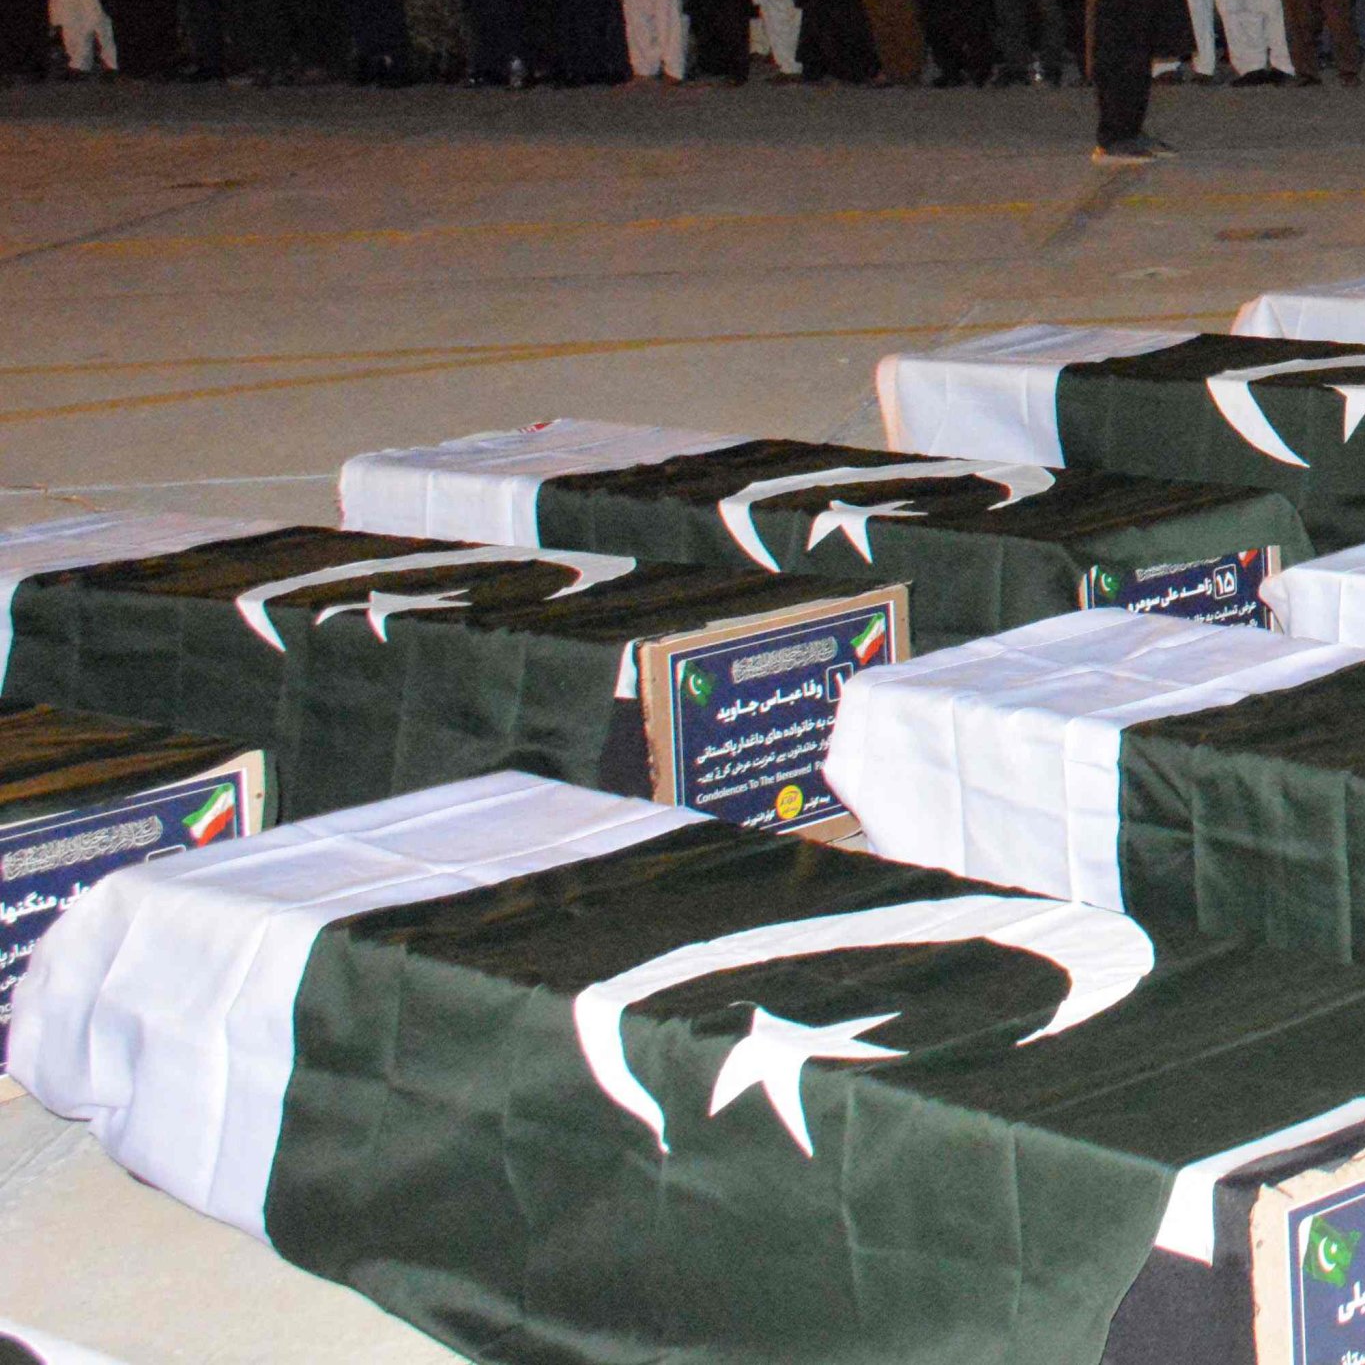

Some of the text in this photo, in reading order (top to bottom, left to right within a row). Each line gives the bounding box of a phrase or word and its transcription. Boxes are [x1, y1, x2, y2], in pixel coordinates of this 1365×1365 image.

[1216, 572, 1235, 594] ۱۵
[1160, 587, 1178, 607] علی
[802, 679, 823, 699] وفا
[760, 689, 803, 713] عباس
[748, 779, 759, 789] To
[760, 775, 775, 786] The
